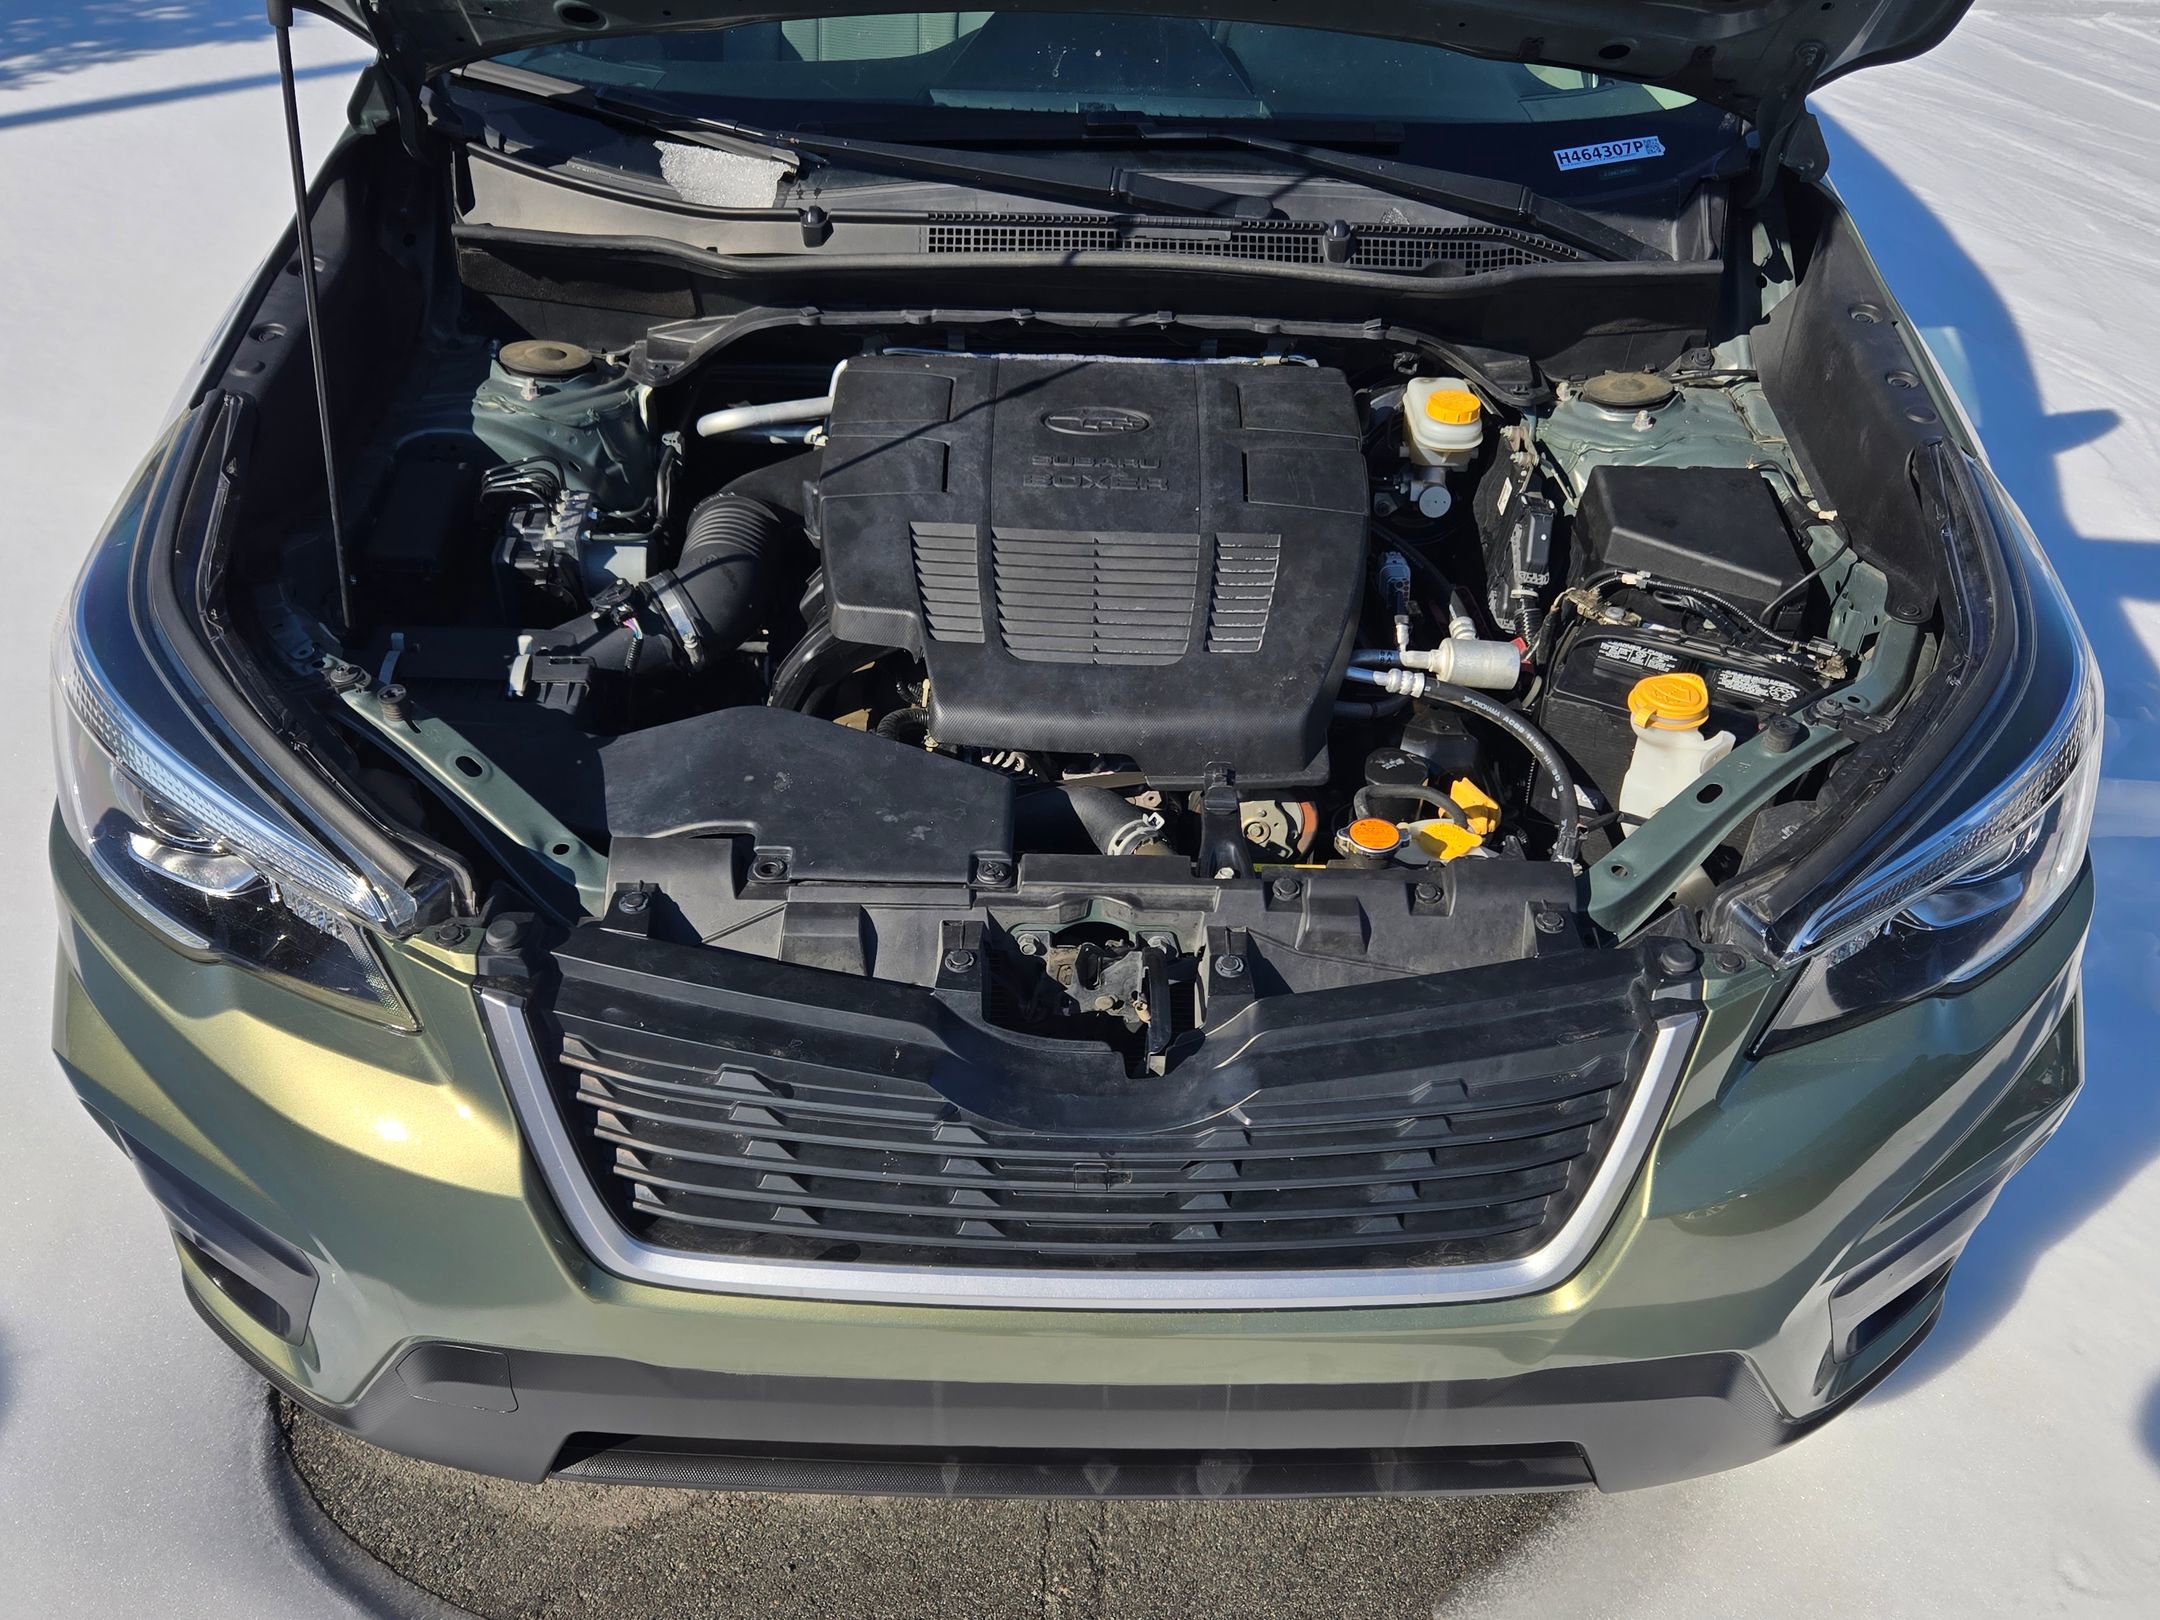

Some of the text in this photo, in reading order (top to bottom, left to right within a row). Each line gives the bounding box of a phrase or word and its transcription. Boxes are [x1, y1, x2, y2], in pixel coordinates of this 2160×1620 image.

[1557, 140, 1643, 164] H464307P
[1032, 455, 1161, 469] SUBARU
[1023, 473, 1169, 491] BOXER
